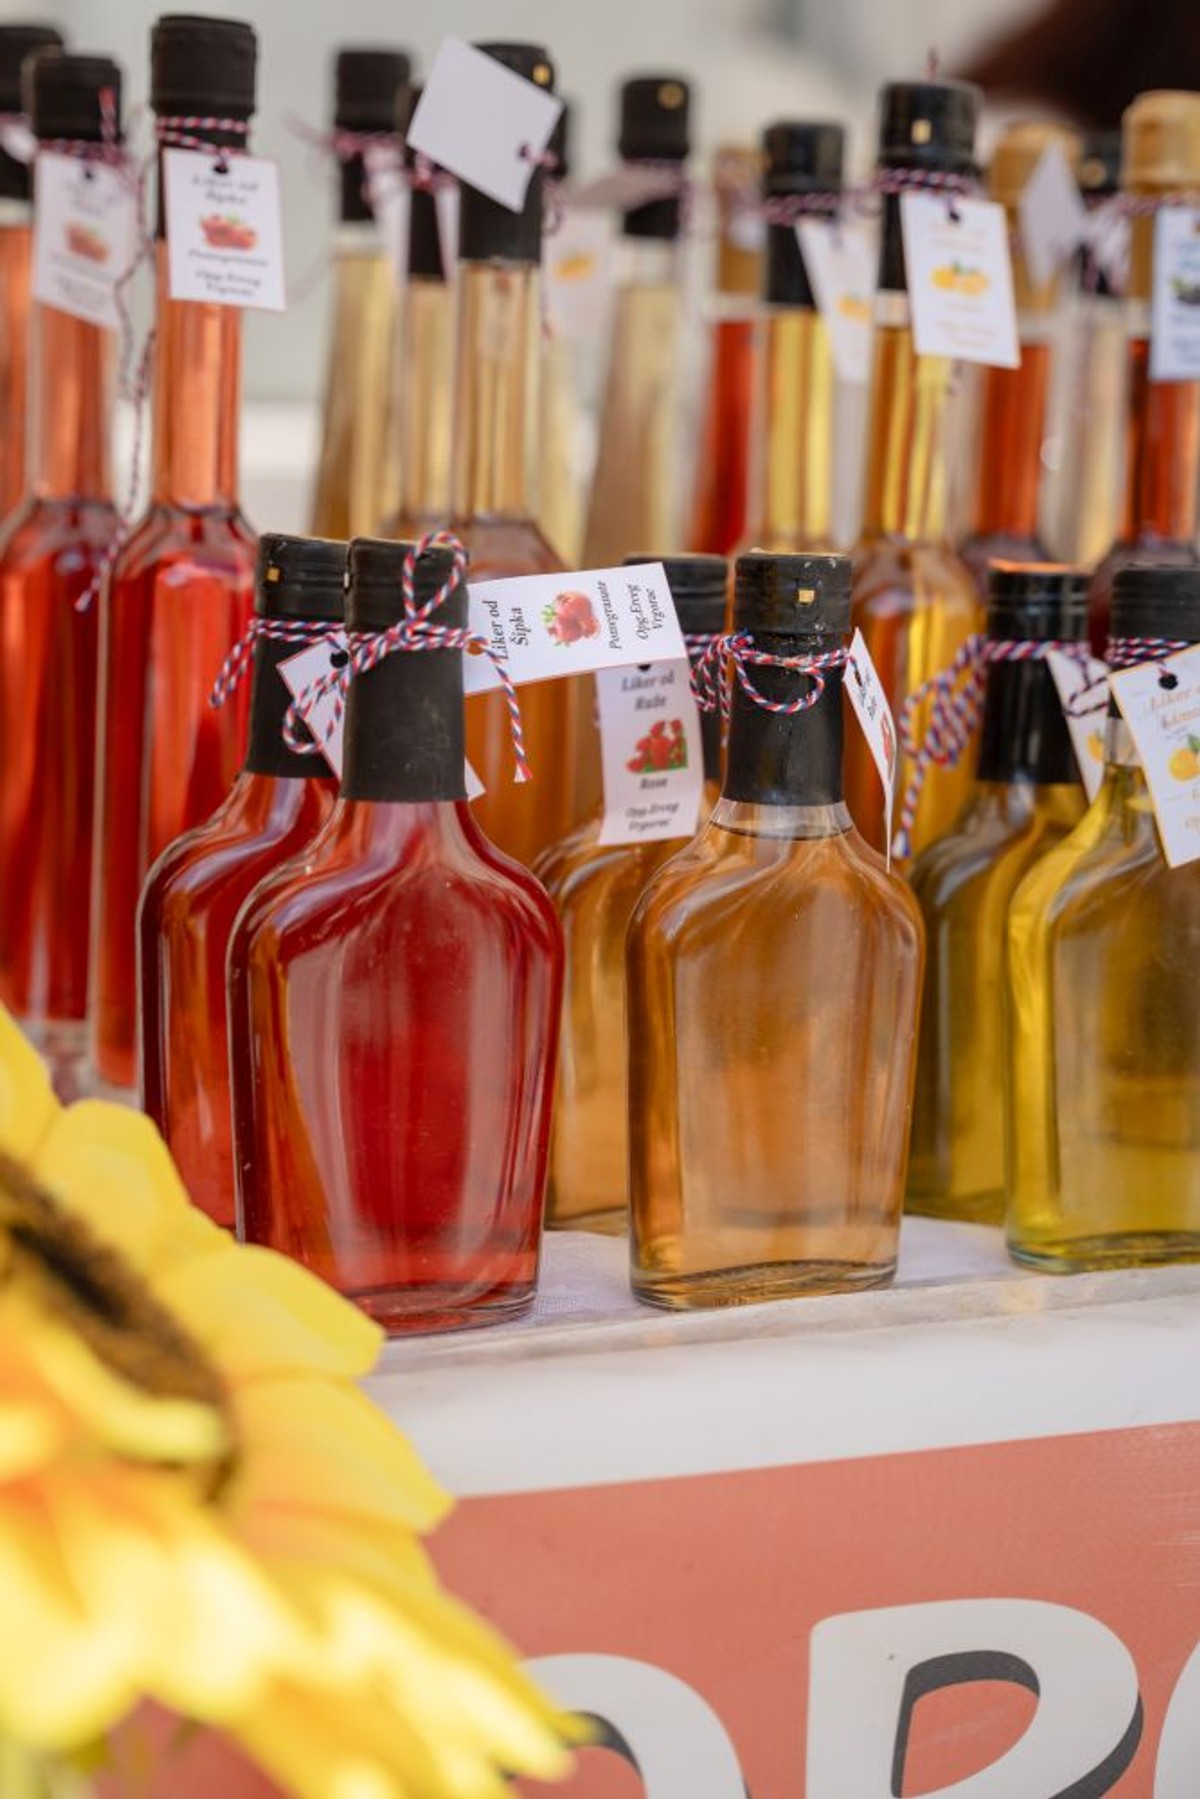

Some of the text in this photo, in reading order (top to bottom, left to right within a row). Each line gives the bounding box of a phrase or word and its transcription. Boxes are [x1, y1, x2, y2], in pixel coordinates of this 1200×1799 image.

[482, 600, 509, 660] Liker od
[508, 607, 532, 647] Šipka
[597, 580, 622, 650] Pomegranate
